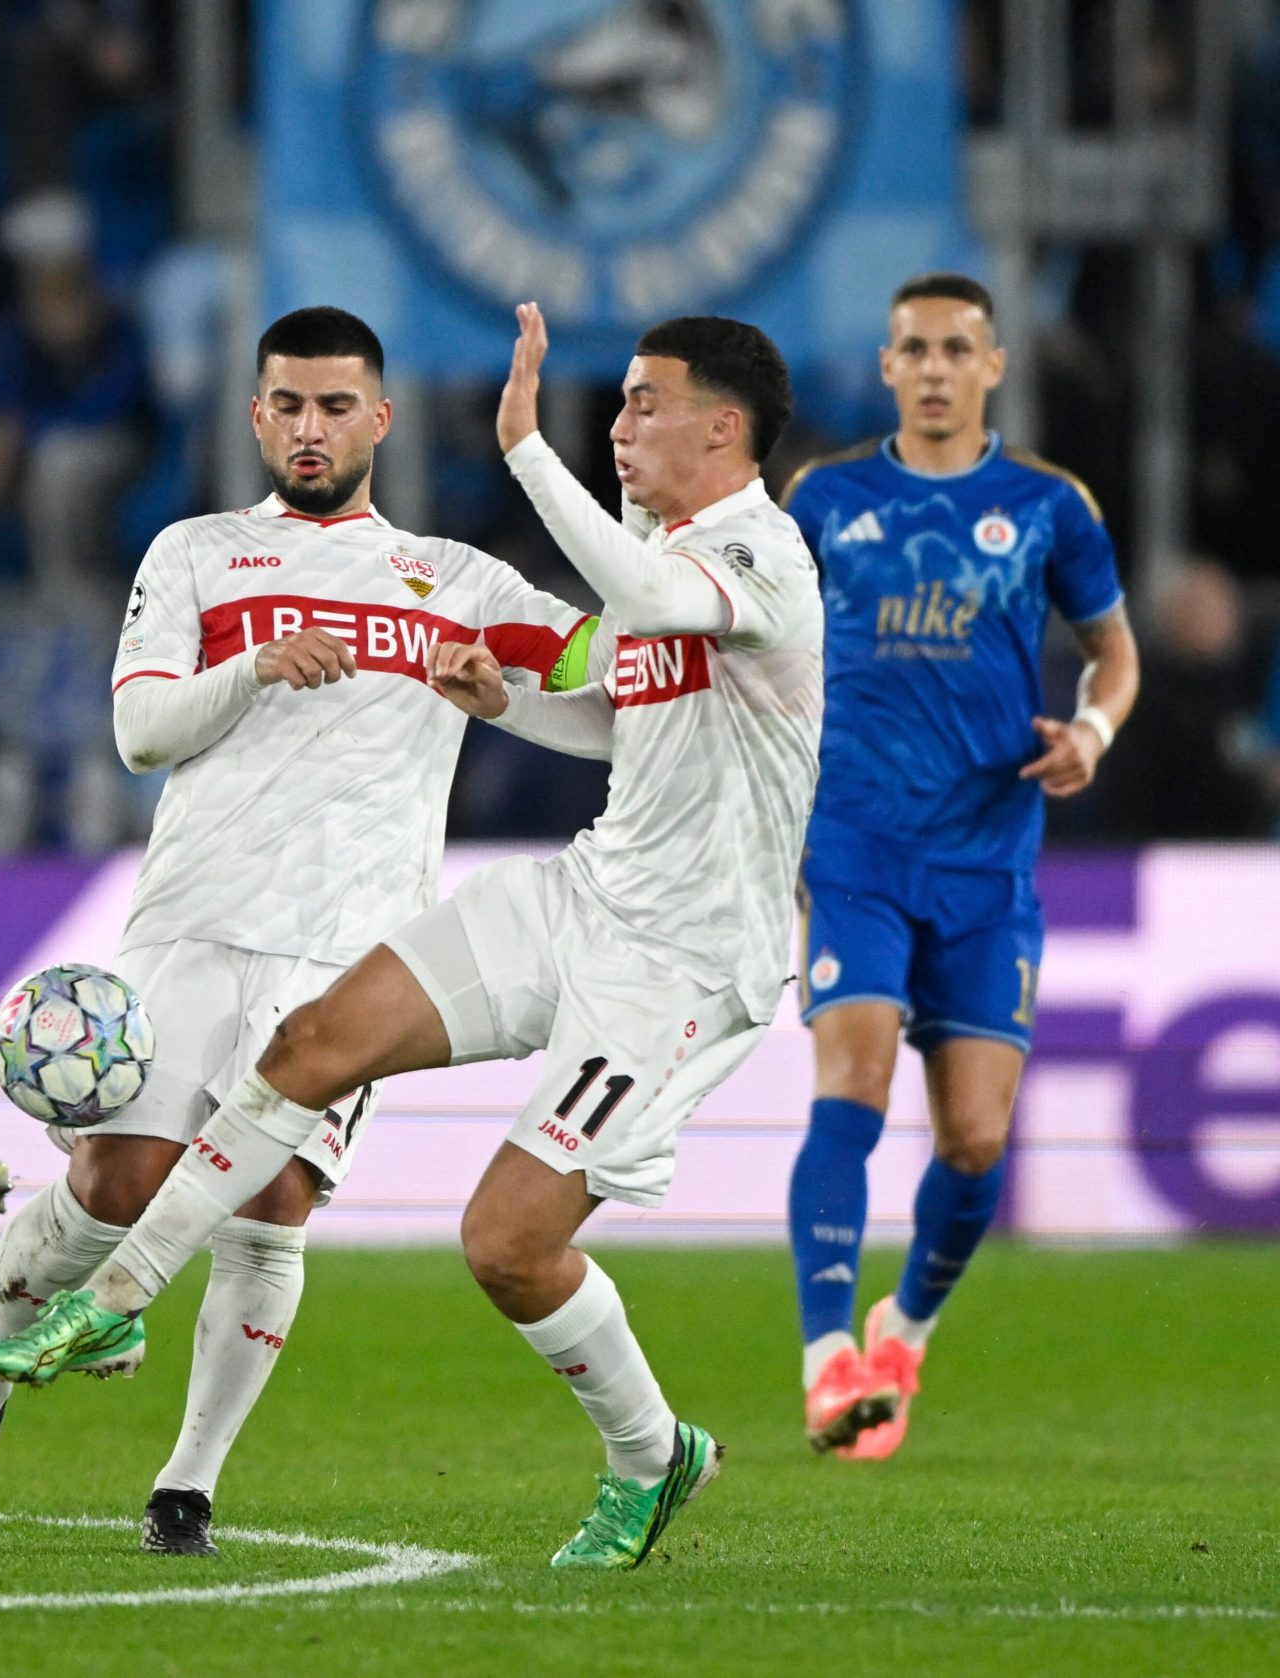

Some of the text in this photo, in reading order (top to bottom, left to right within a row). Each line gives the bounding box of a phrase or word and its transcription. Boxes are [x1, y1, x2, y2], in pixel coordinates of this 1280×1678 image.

[228, 556, 282, 570] JAKO
[554, 1056, 635, 1141] 11
[537, 1119, 579, 1152] JAKO
